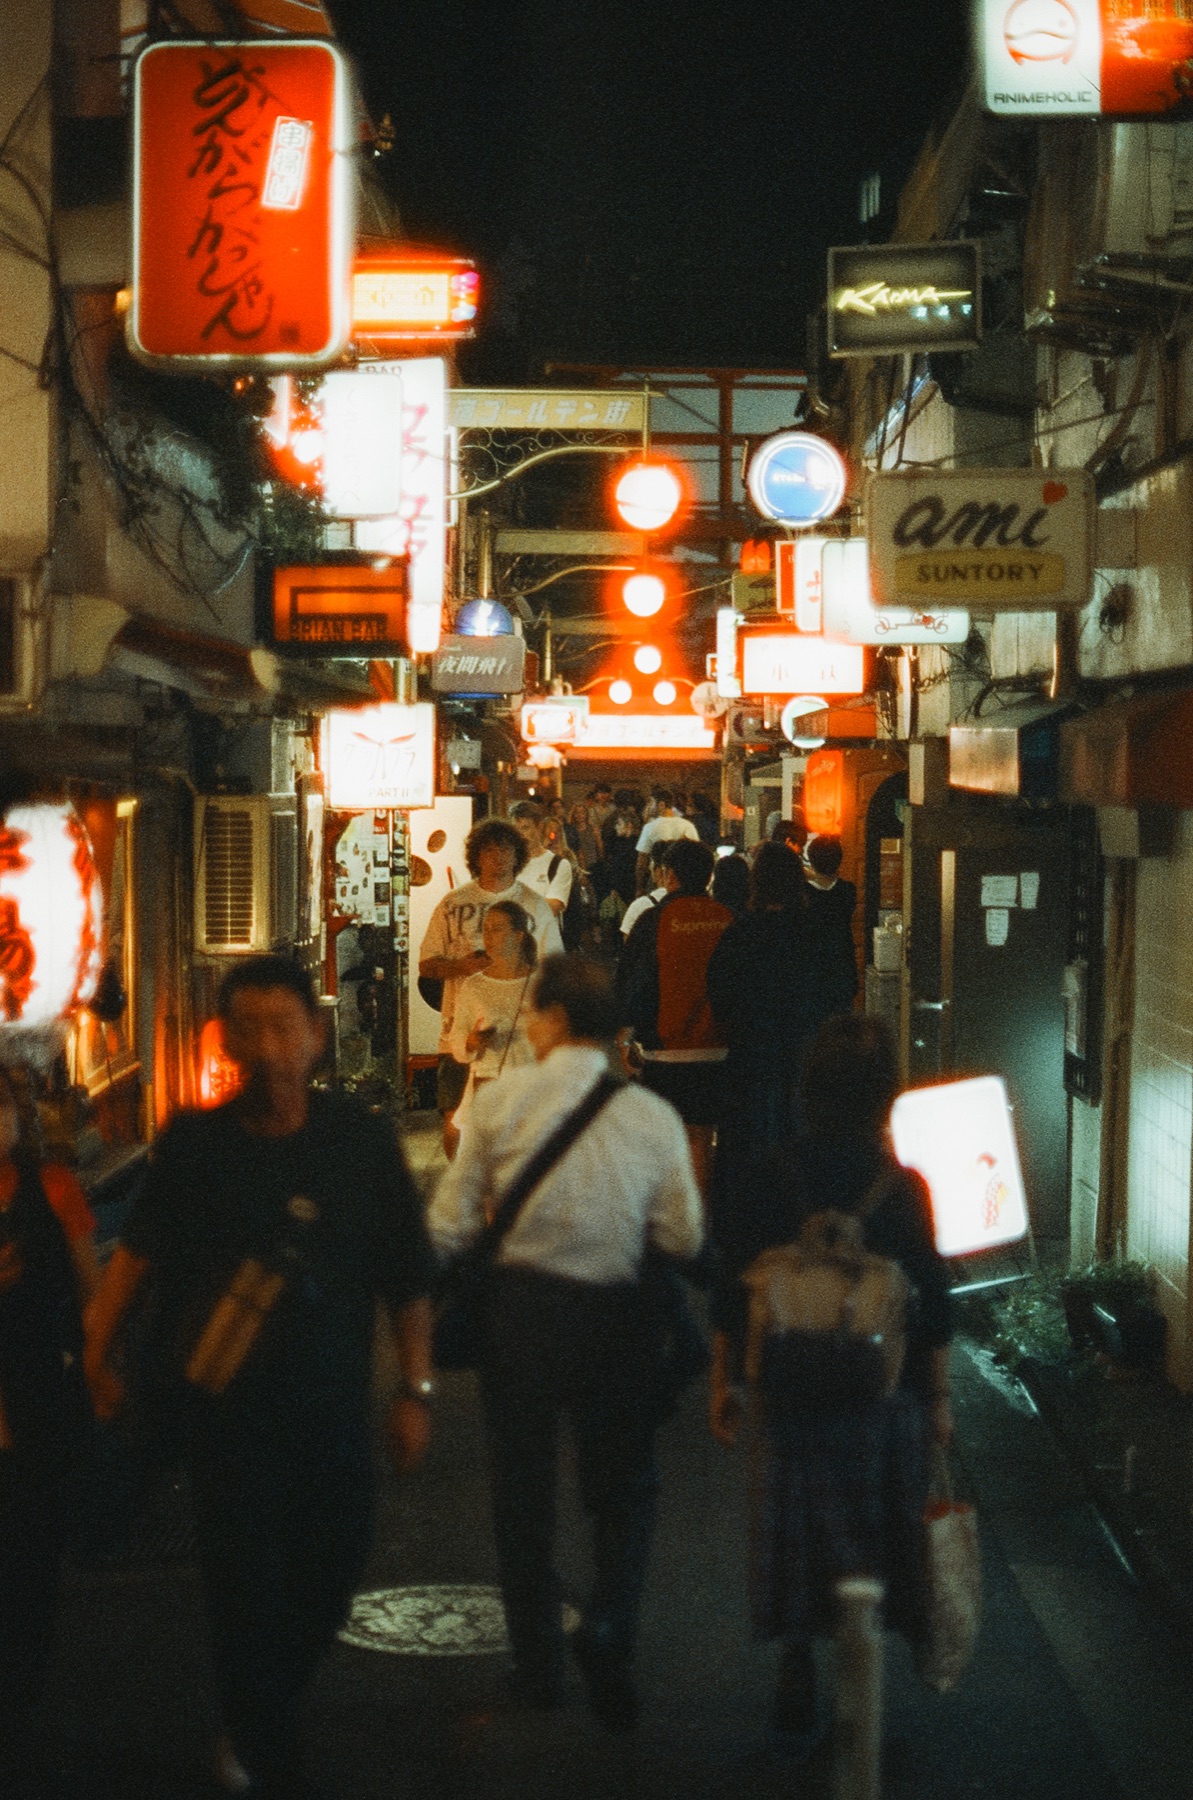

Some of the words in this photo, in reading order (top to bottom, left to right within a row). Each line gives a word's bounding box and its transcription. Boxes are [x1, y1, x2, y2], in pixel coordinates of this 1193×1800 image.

[993, 91, 1092, 104] ANIMEHOLIC
[892, 494, 1051, 549] ami
[917, 562, 1045, 584] SUNTORY
